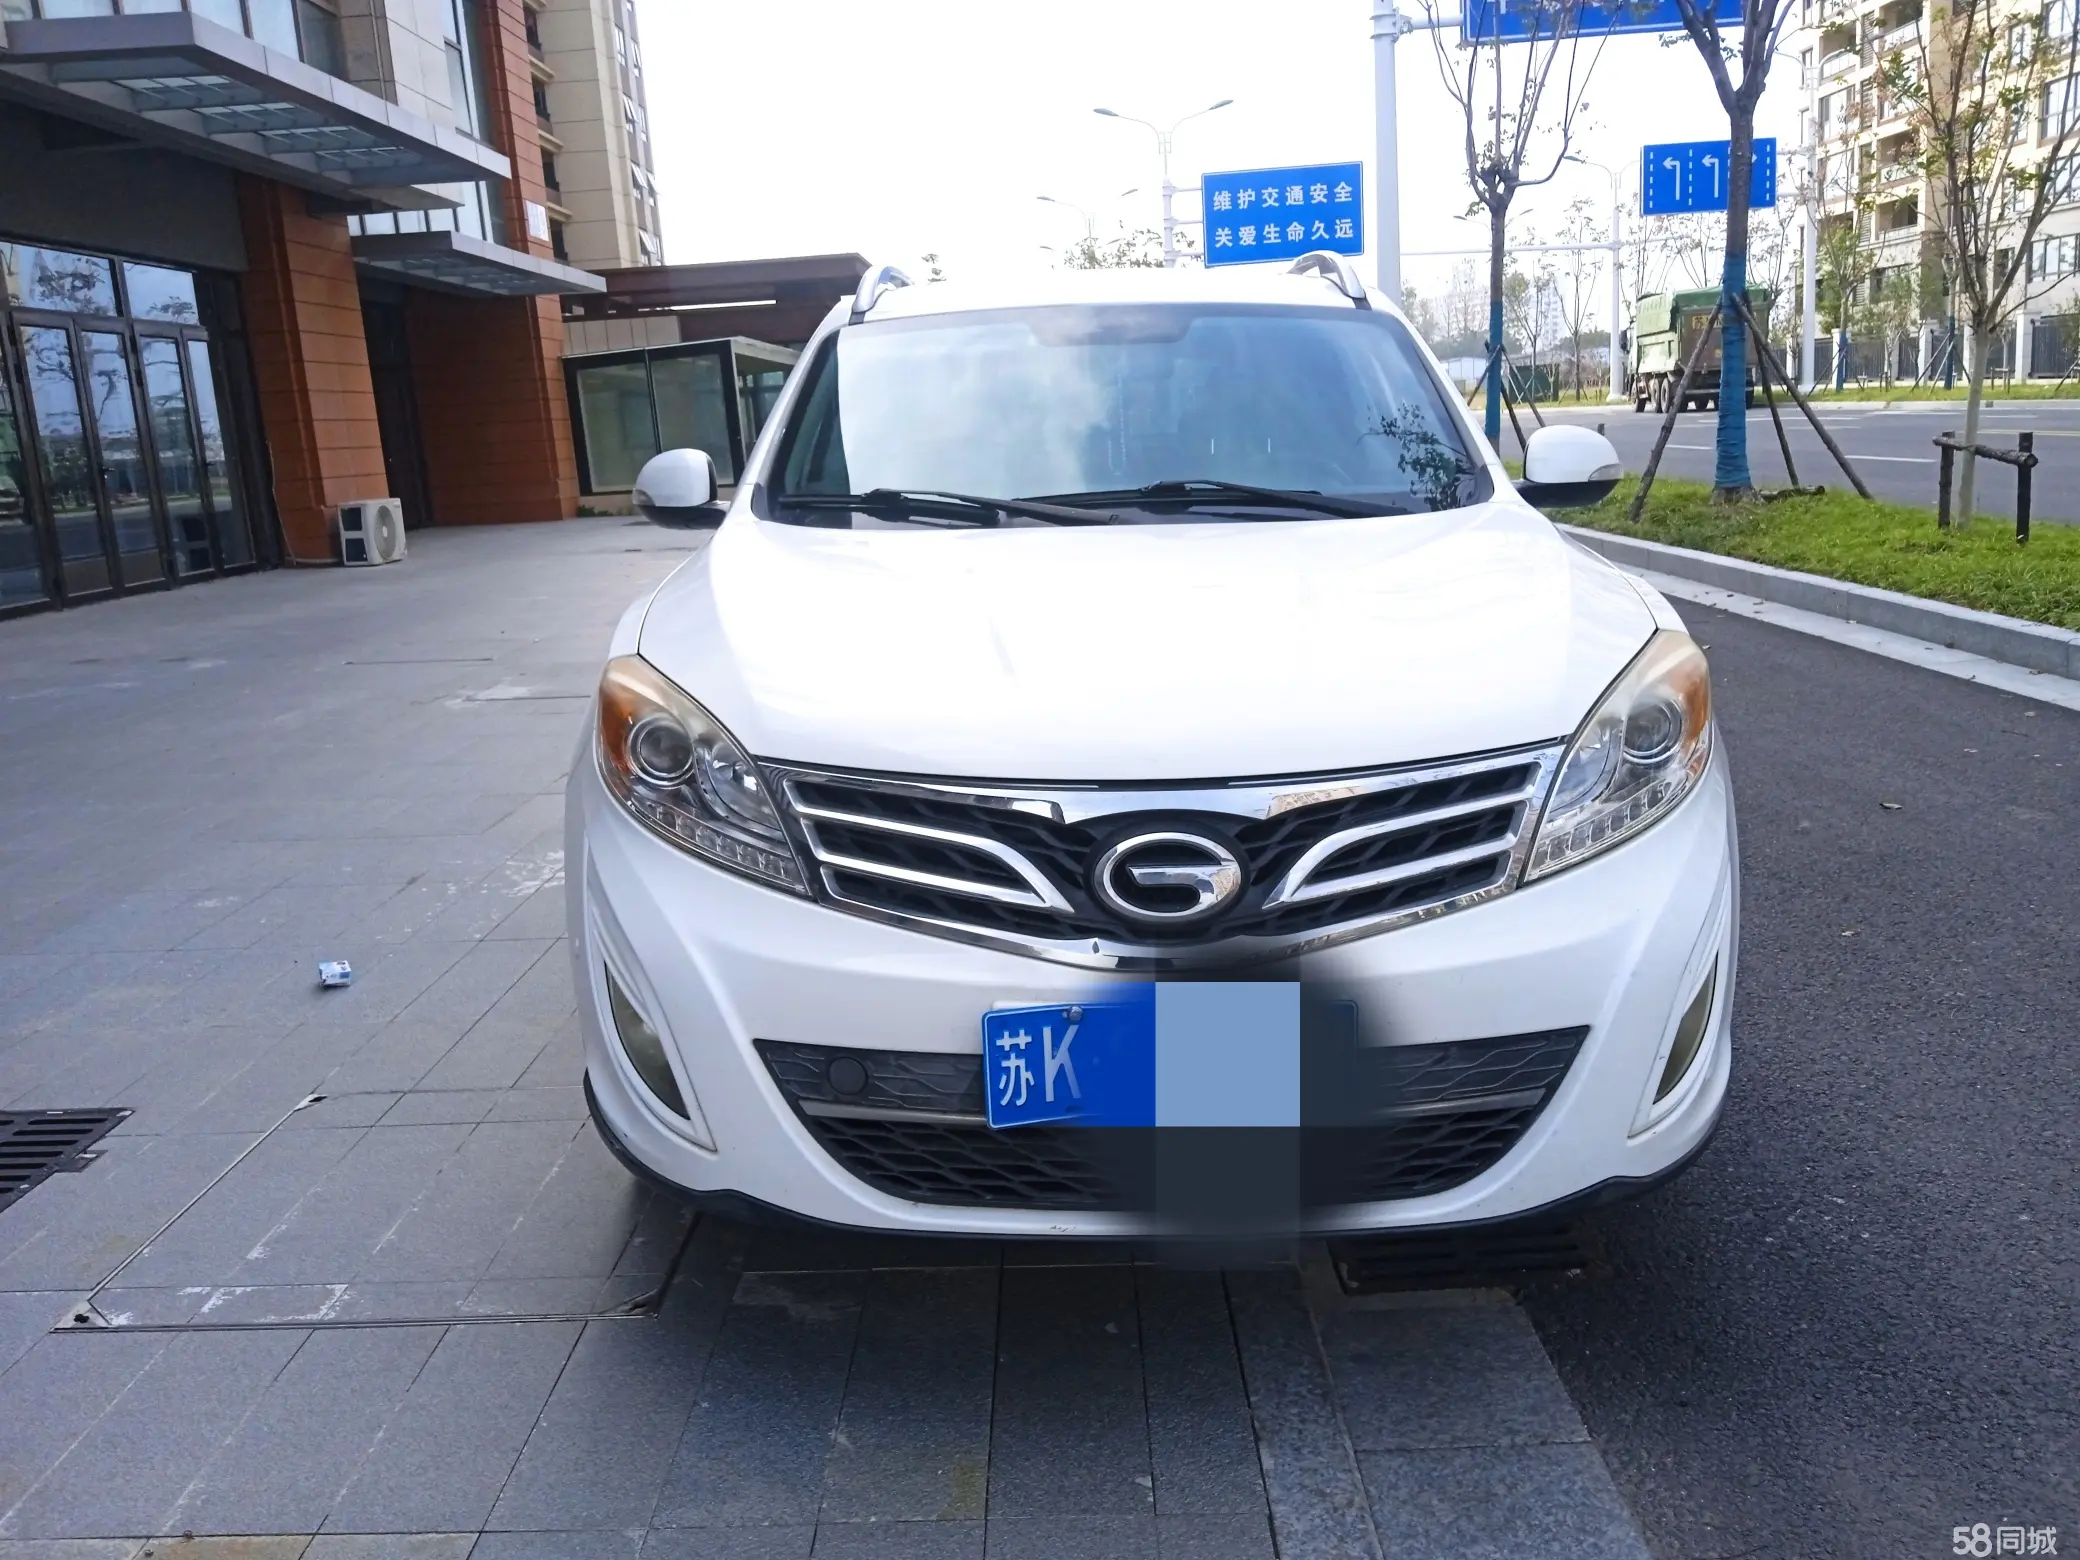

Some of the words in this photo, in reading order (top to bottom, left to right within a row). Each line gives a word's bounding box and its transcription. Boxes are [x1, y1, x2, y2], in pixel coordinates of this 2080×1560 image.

[1213, 181, 1353, 212] 维护交通安全
[1214, 218, 1354, 249] 关爱生命久远
